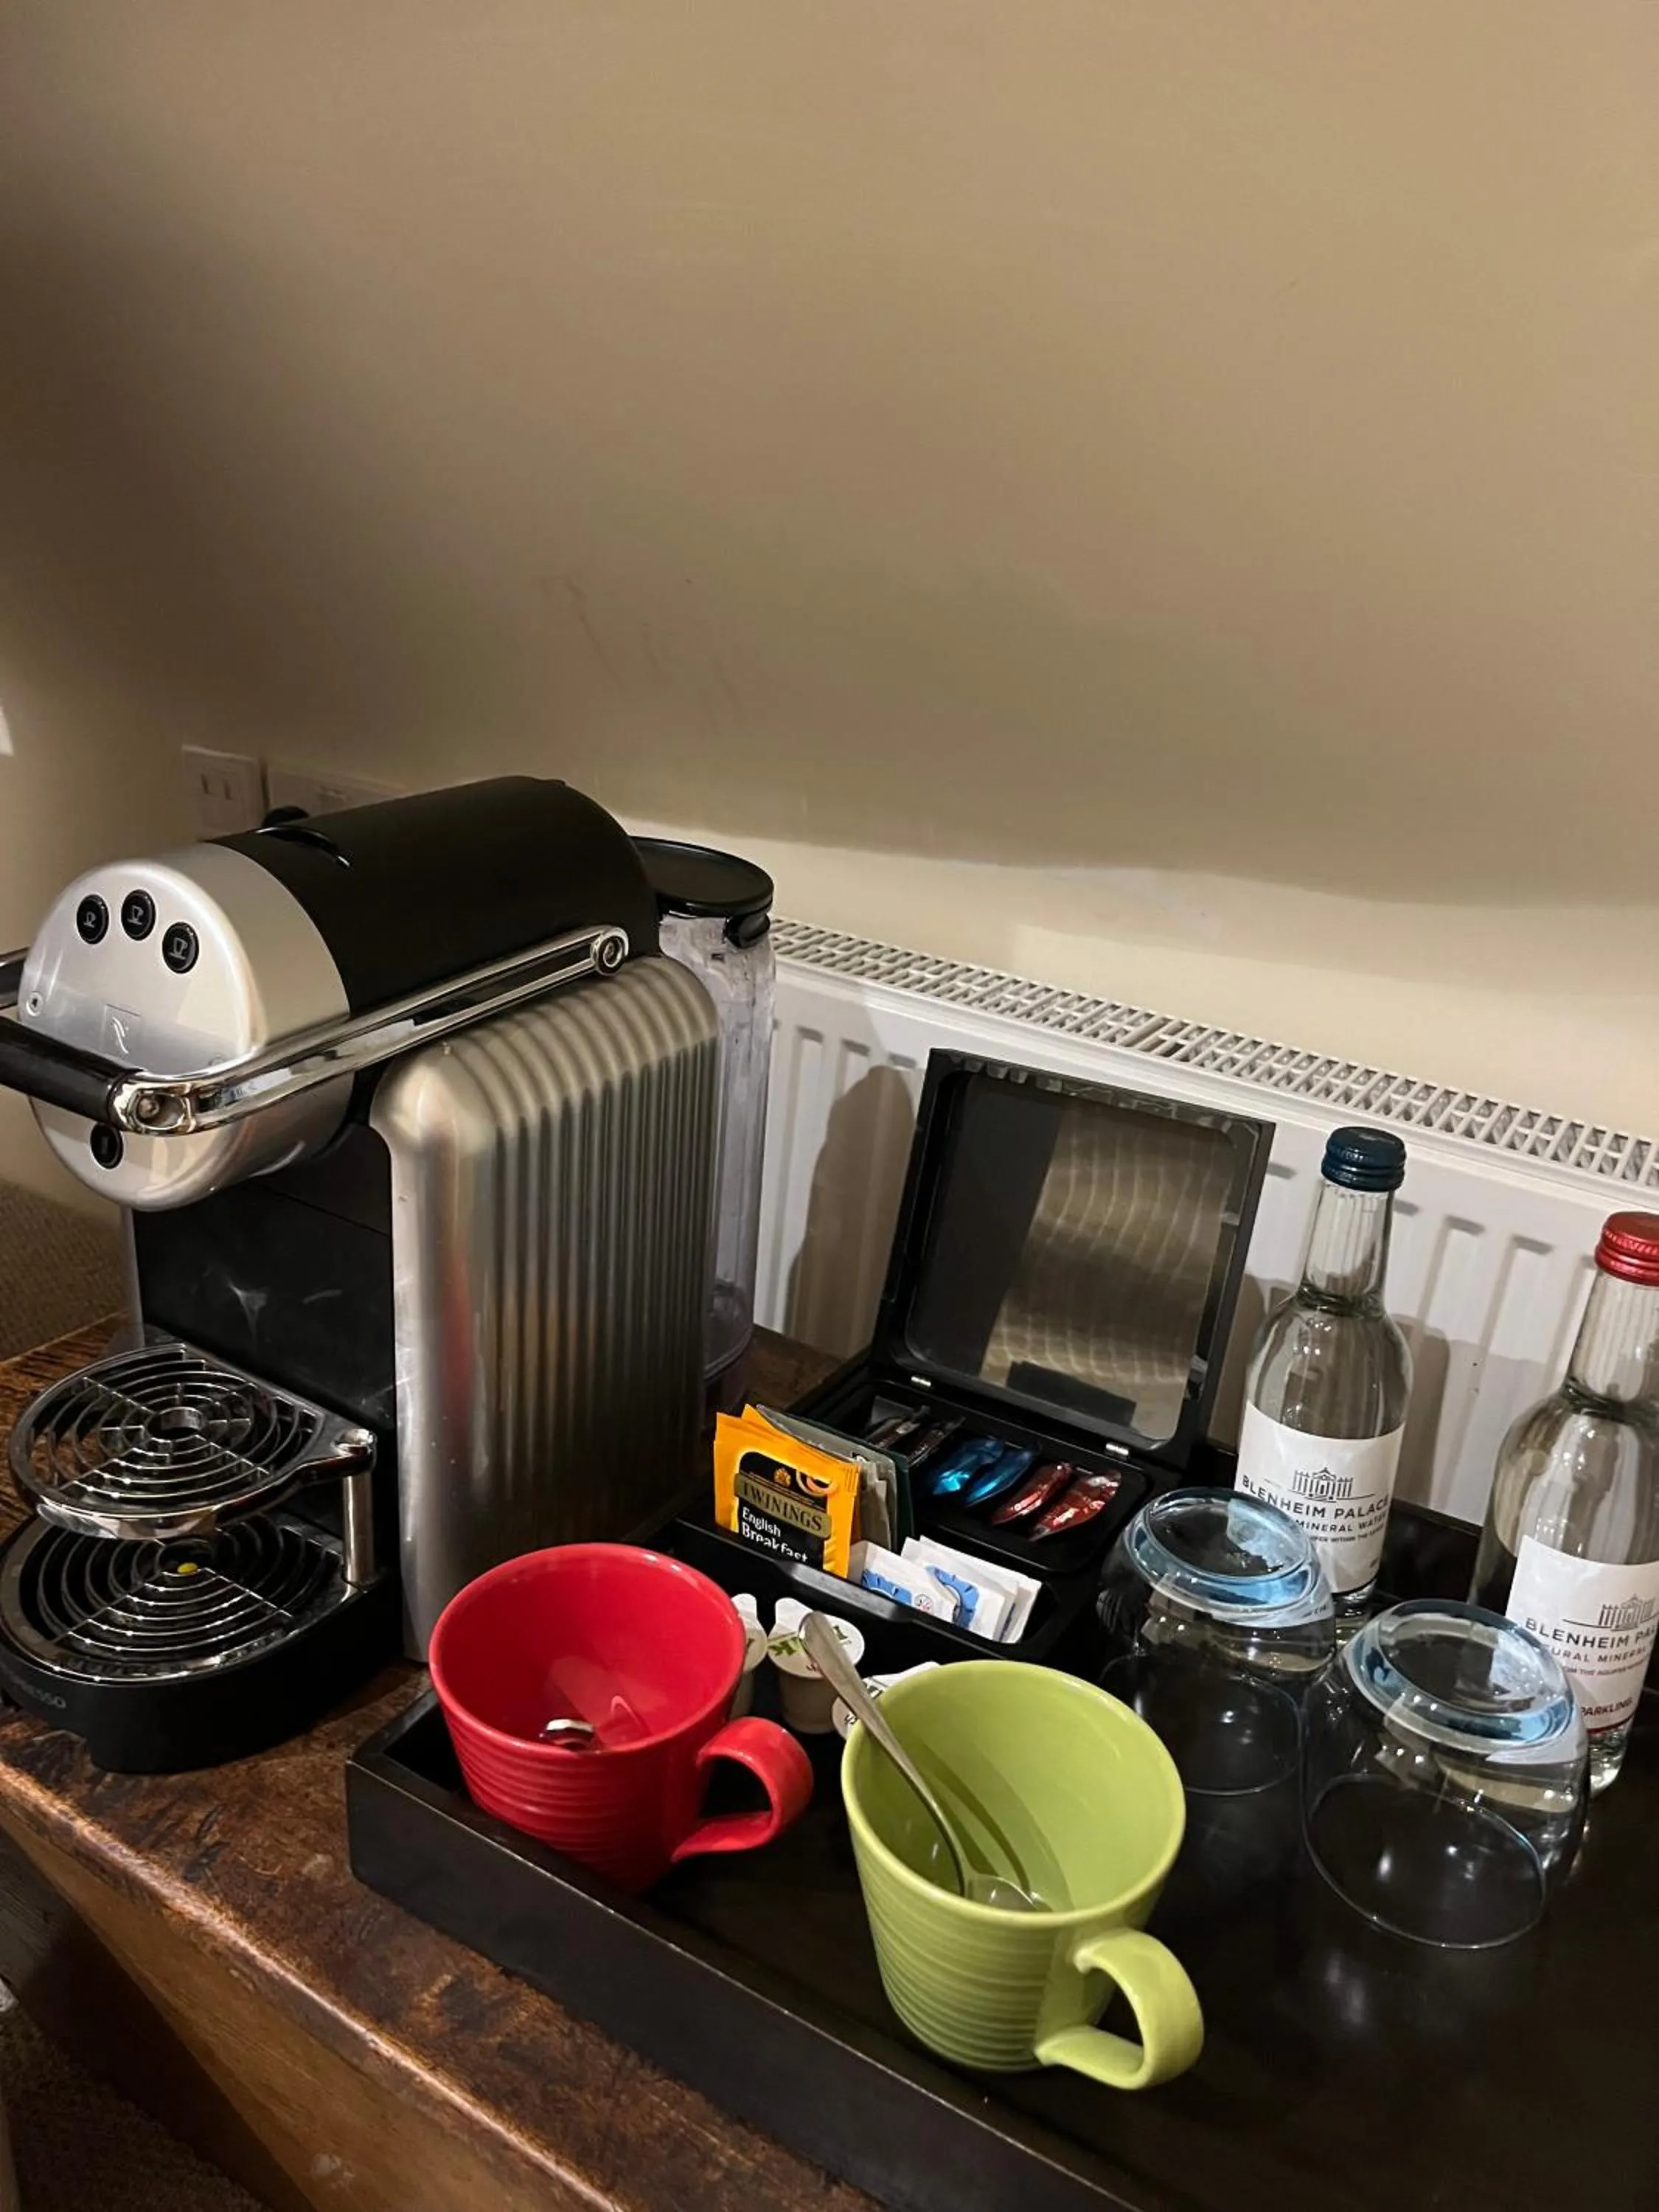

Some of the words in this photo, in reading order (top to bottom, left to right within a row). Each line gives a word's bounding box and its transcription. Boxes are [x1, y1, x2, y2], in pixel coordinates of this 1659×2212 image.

[742, 1482, 822, 1531] TWININGS
[1242, 1475, 1326, 1518] BLENHEIM
[742, 1506, 781, 1537] English
[1295, 1519, 1353, 1533] MINERAL
[742, 1521, 808, 1562] Breakfast
[1526, 1618, 1630, 1649] BLENHEIM
[1581, 1697, 1632, 1717] PARKLING
